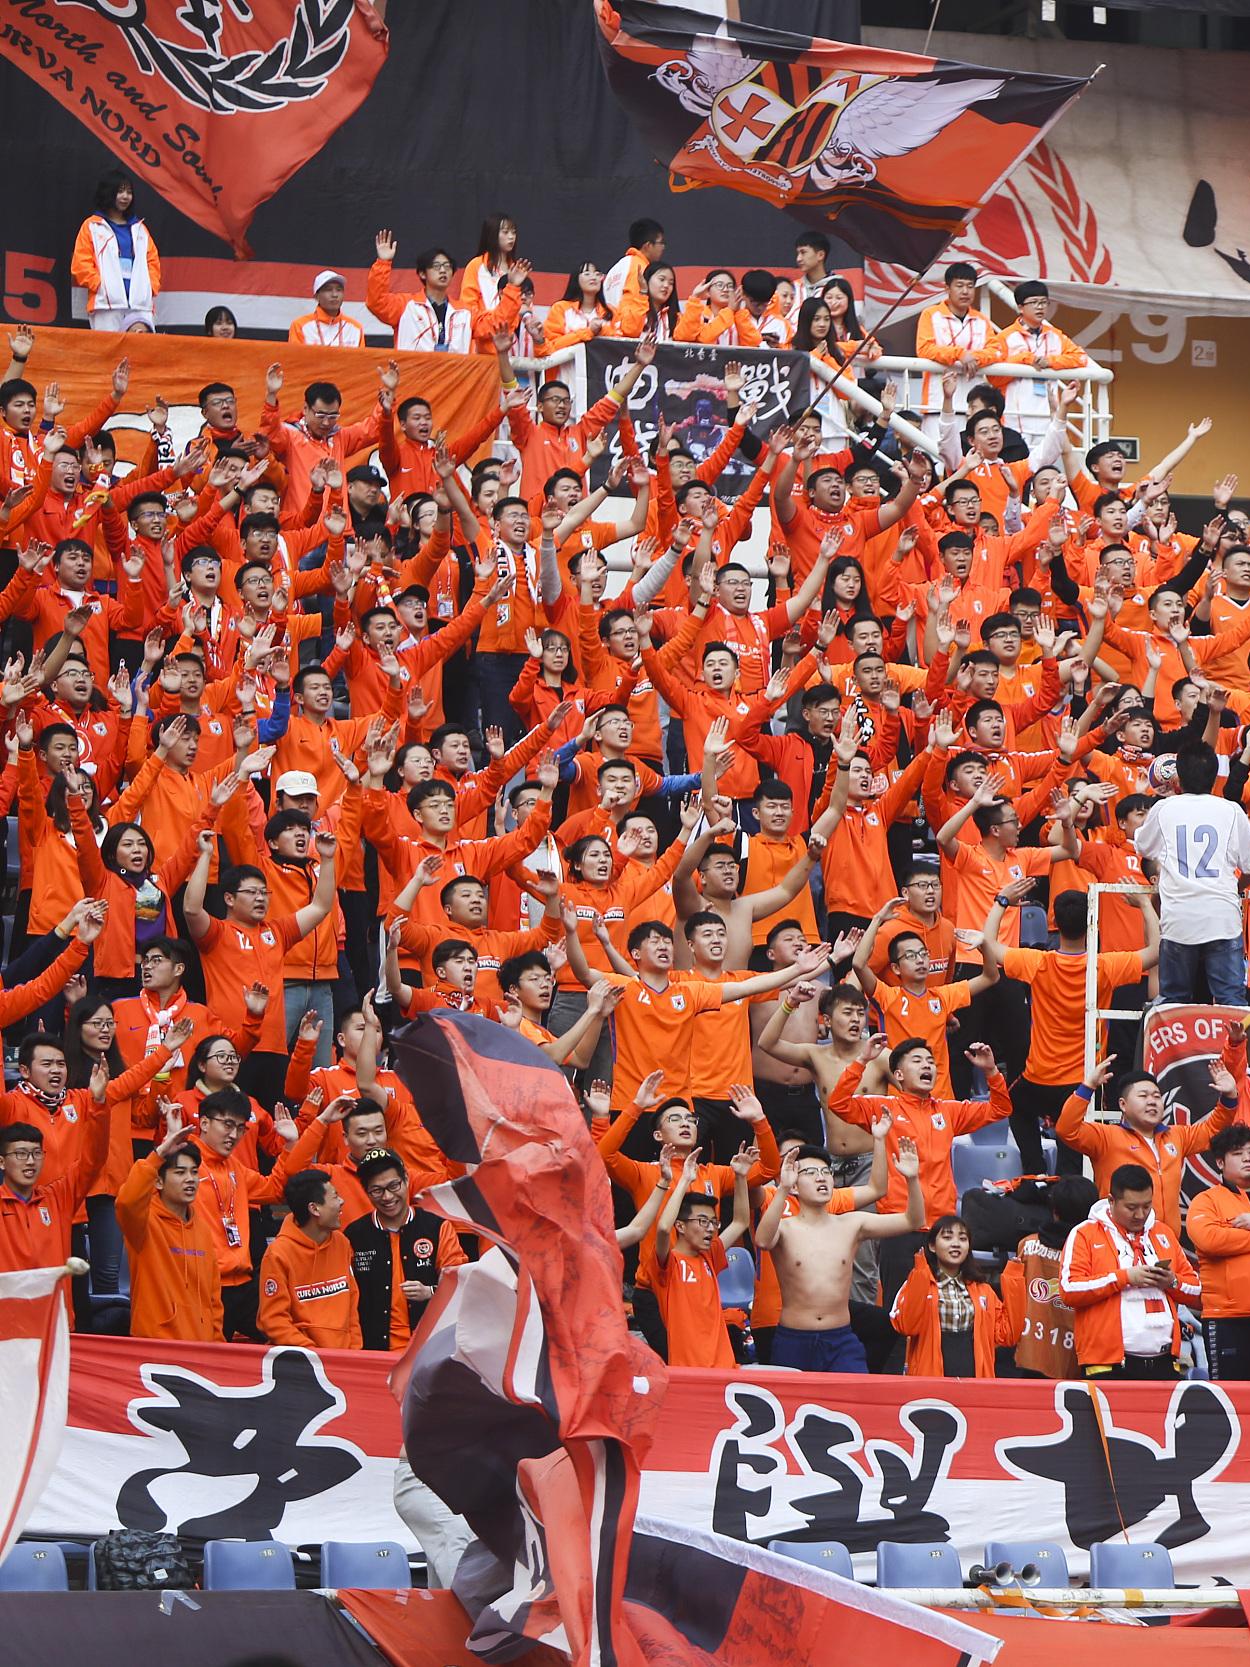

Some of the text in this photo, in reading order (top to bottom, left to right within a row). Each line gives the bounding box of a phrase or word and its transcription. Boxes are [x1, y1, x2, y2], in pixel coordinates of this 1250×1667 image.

[106, 72, 167, 121] and
[80, 86, 162, 168] NORD
[3, 250, 58, 323] 5
[1126, 855, 1141, 873] 12
[1176, 823, 1220, 879] 12
[605, 910, 624, 919] NORD
[1149, 1021, 1188, 1056] ERS
[1193, 1018, 1224, 1045] OF
[322, 1279, 348, 1295] NORD
[679, 1258, 698, 1283] 12
